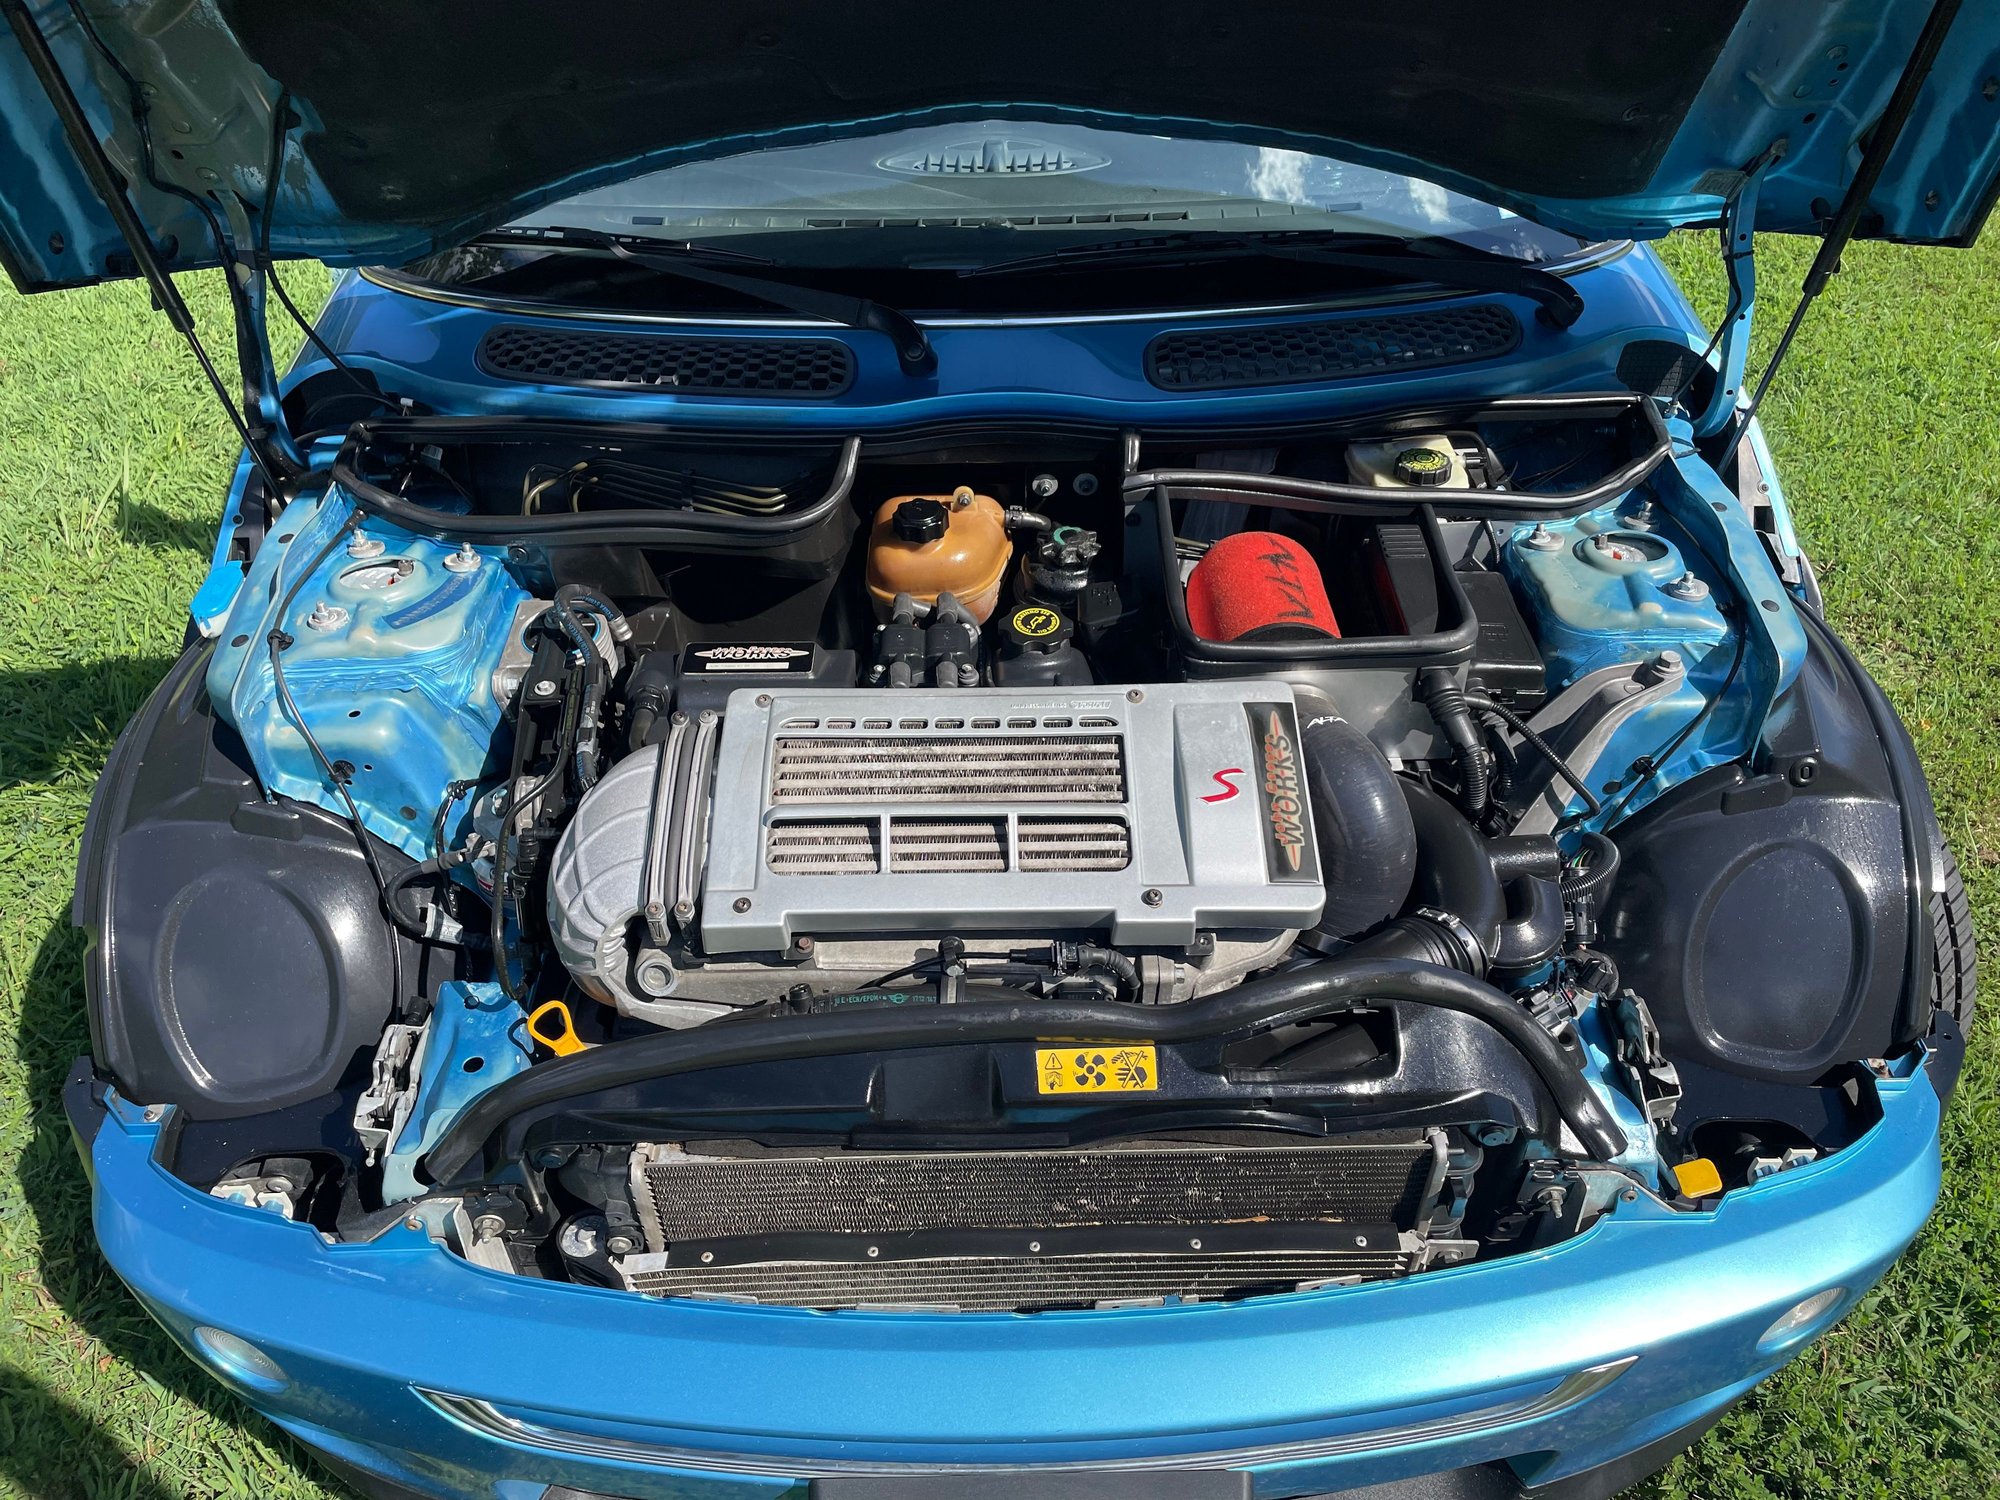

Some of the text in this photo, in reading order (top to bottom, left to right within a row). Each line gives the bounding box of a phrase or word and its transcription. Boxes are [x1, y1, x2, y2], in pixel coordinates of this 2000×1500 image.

[710, 648, 792, 660] WORKS
[1307, 715, 1349, 729] ALTA
[1197, 767, 1247, 804] S
[1271, 735, 1305, 847] WORKS
